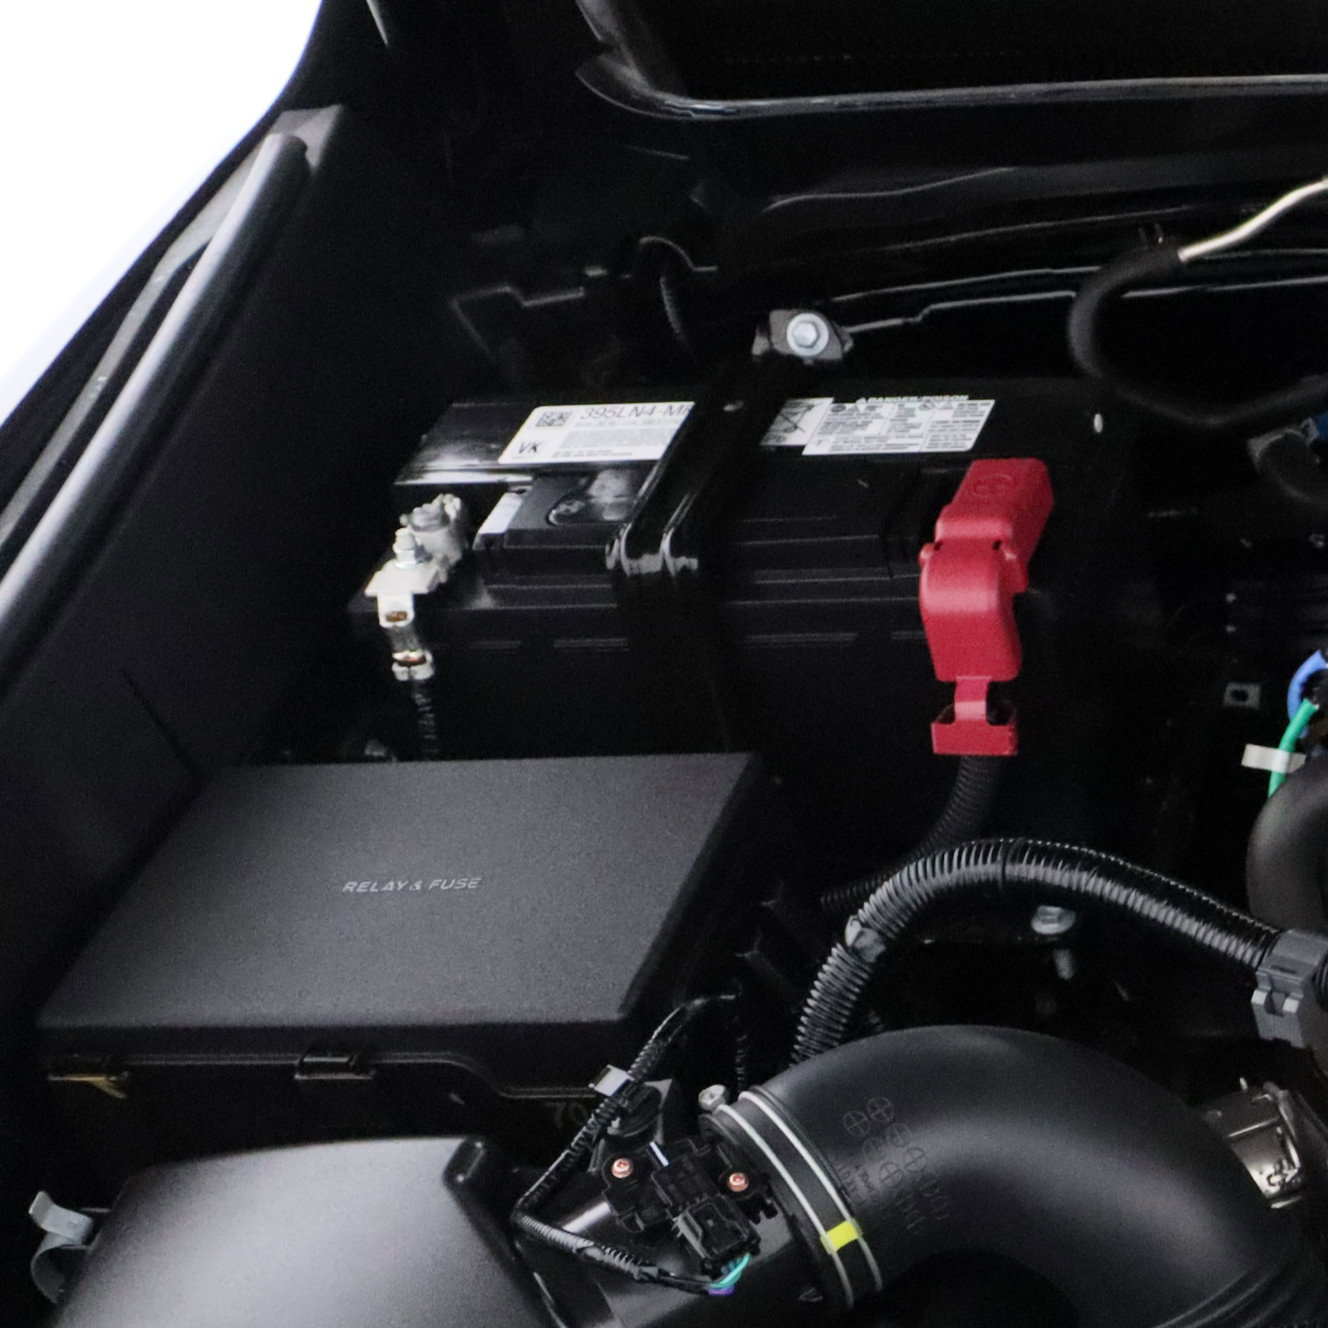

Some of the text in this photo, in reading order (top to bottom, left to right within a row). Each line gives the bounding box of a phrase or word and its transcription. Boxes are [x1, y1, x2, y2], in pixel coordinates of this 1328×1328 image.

[518, 441, 543, 454] VK
[342, 877, 483, 893] RELAY & FUSE
